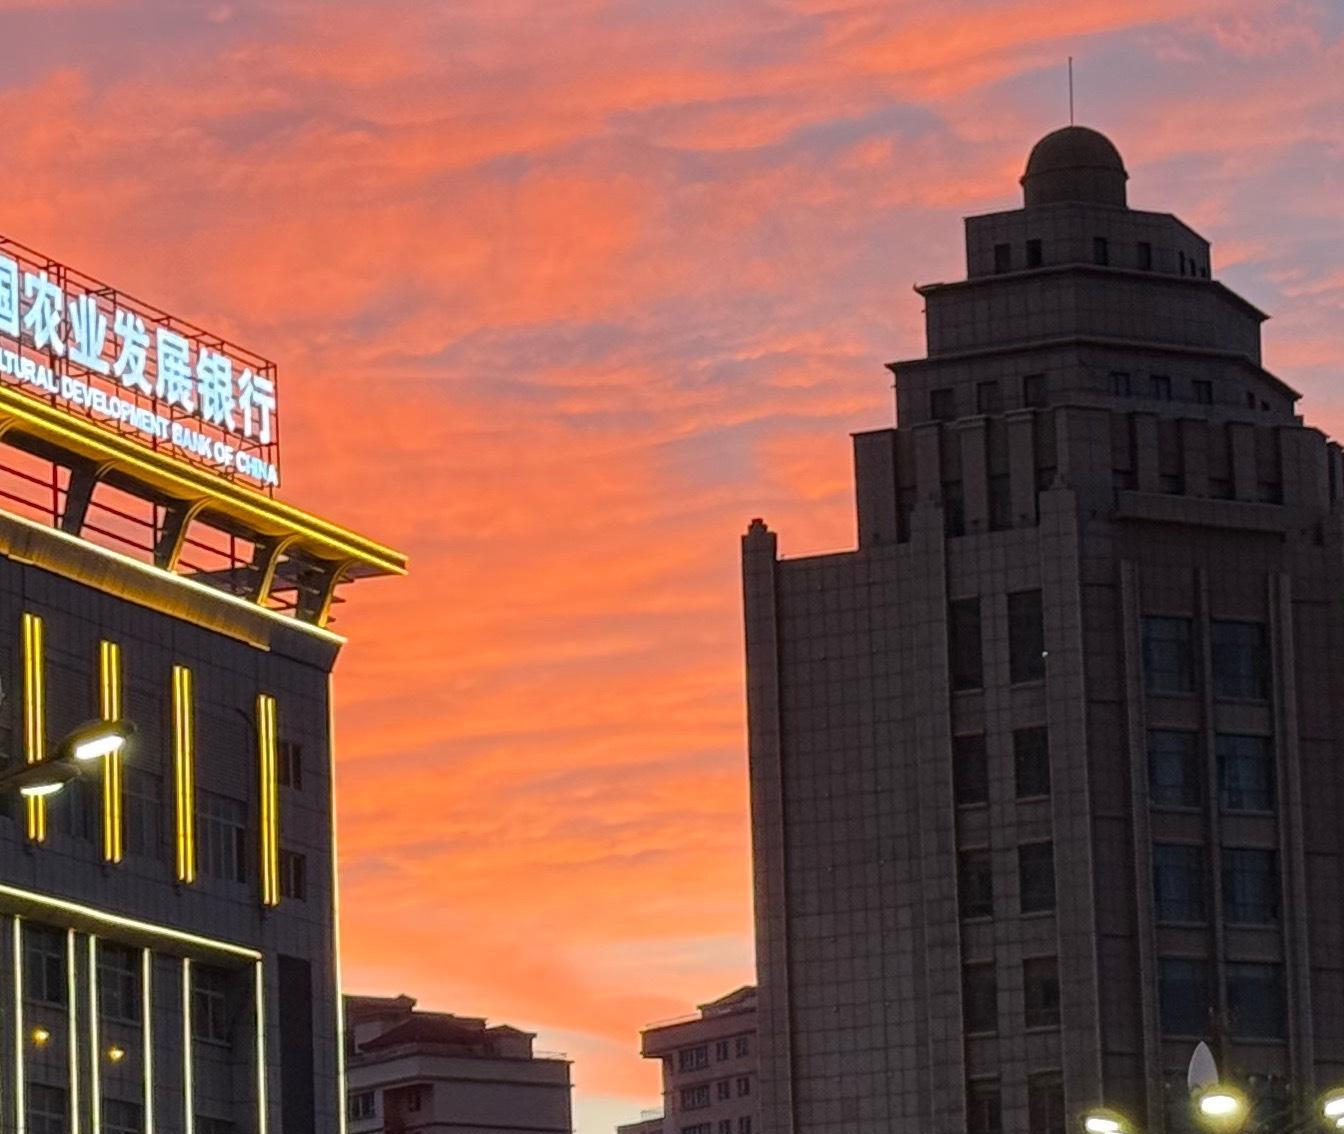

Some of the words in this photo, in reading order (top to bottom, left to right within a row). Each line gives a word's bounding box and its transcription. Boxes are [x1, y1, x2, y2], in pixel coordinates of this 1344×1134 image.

[61, 374, 170, 440] DEVELOPMENT
[172, 421, 213, 460] BANK
[214, 441, 234, 466] OF
[236, 450, 279, 486] CHINA
